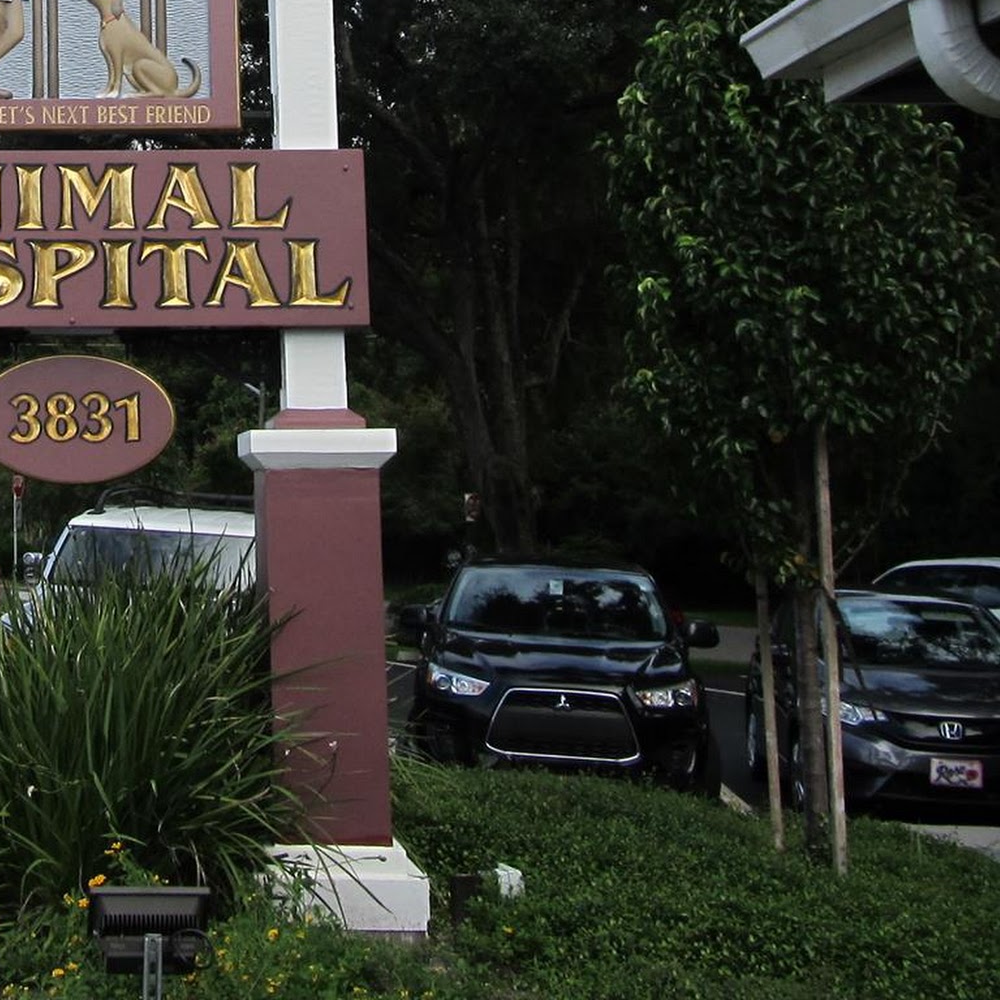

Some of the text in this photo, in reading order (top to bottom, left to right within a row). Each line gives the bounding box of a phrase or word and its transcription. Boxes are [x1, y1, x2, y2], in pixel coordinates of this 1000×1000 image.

[42, 104, 89, 124] NEXT
[98, 104, 138, 124] BEST
[146, 104, 211, 124] FRIEND
[9, 391, 140, 443] 3831
